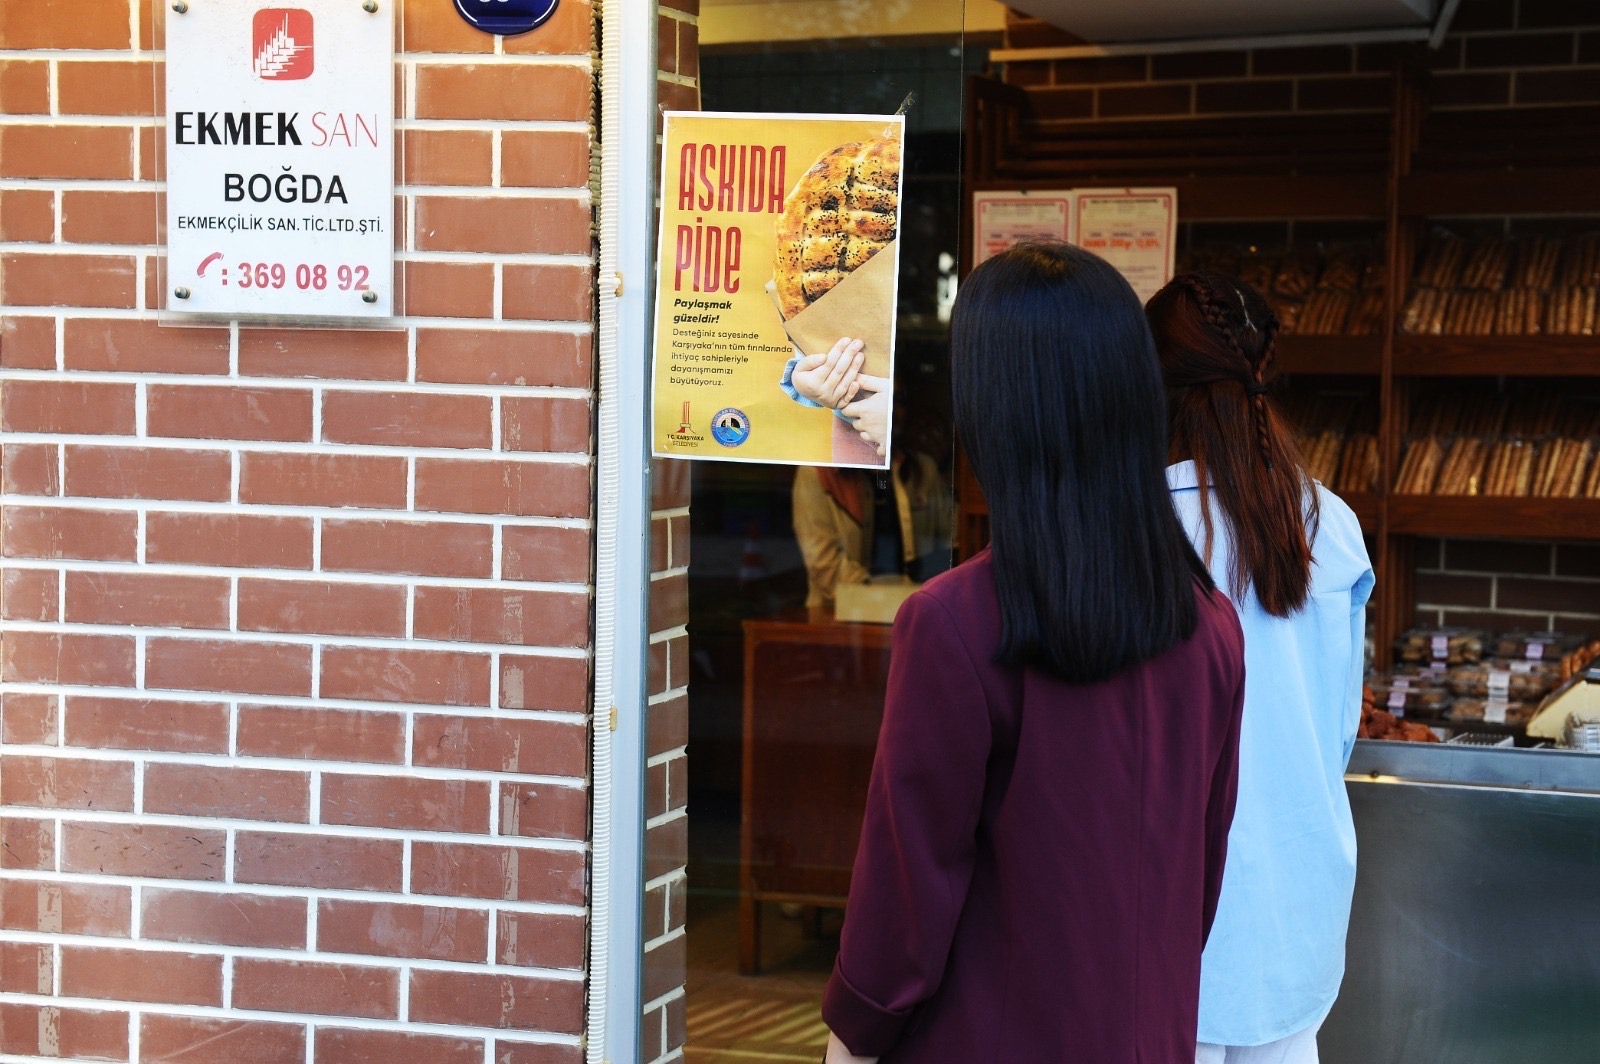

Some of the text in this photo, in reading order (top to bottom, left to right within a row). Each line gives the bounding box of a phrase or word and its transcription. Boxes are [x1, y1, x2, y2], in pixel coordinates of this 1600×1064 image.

[175, 112, 378, 148] EKMEK SAN
[678, 143, 787, 214] ASKIDA
[224, 166, 349, 204] BOĞDA
[178, 214, 263, 233] EKMEKÇİLİK
[267, 217, 300, 231] SAN.
[237, 262, 286, 289] 369
[295, 263, 327, 290] 08
[337, 264, 370, 291] 92
[674, 298, 732, 310] Paylaşmak
[673, 314, 720, 324] güzeldir!
[672, 328, 759, 340] Desteğiniz sayesinde
[729, 343, 746, 351] tüm
[747, 344, 793, 353] fırınlarında
[671, 352, 749, 365] ihtiyaç sahipleriyle
[670, 364, 733, 375] dayanışmamızı
[670, 376, 724, 387] büyütüyoruz.
